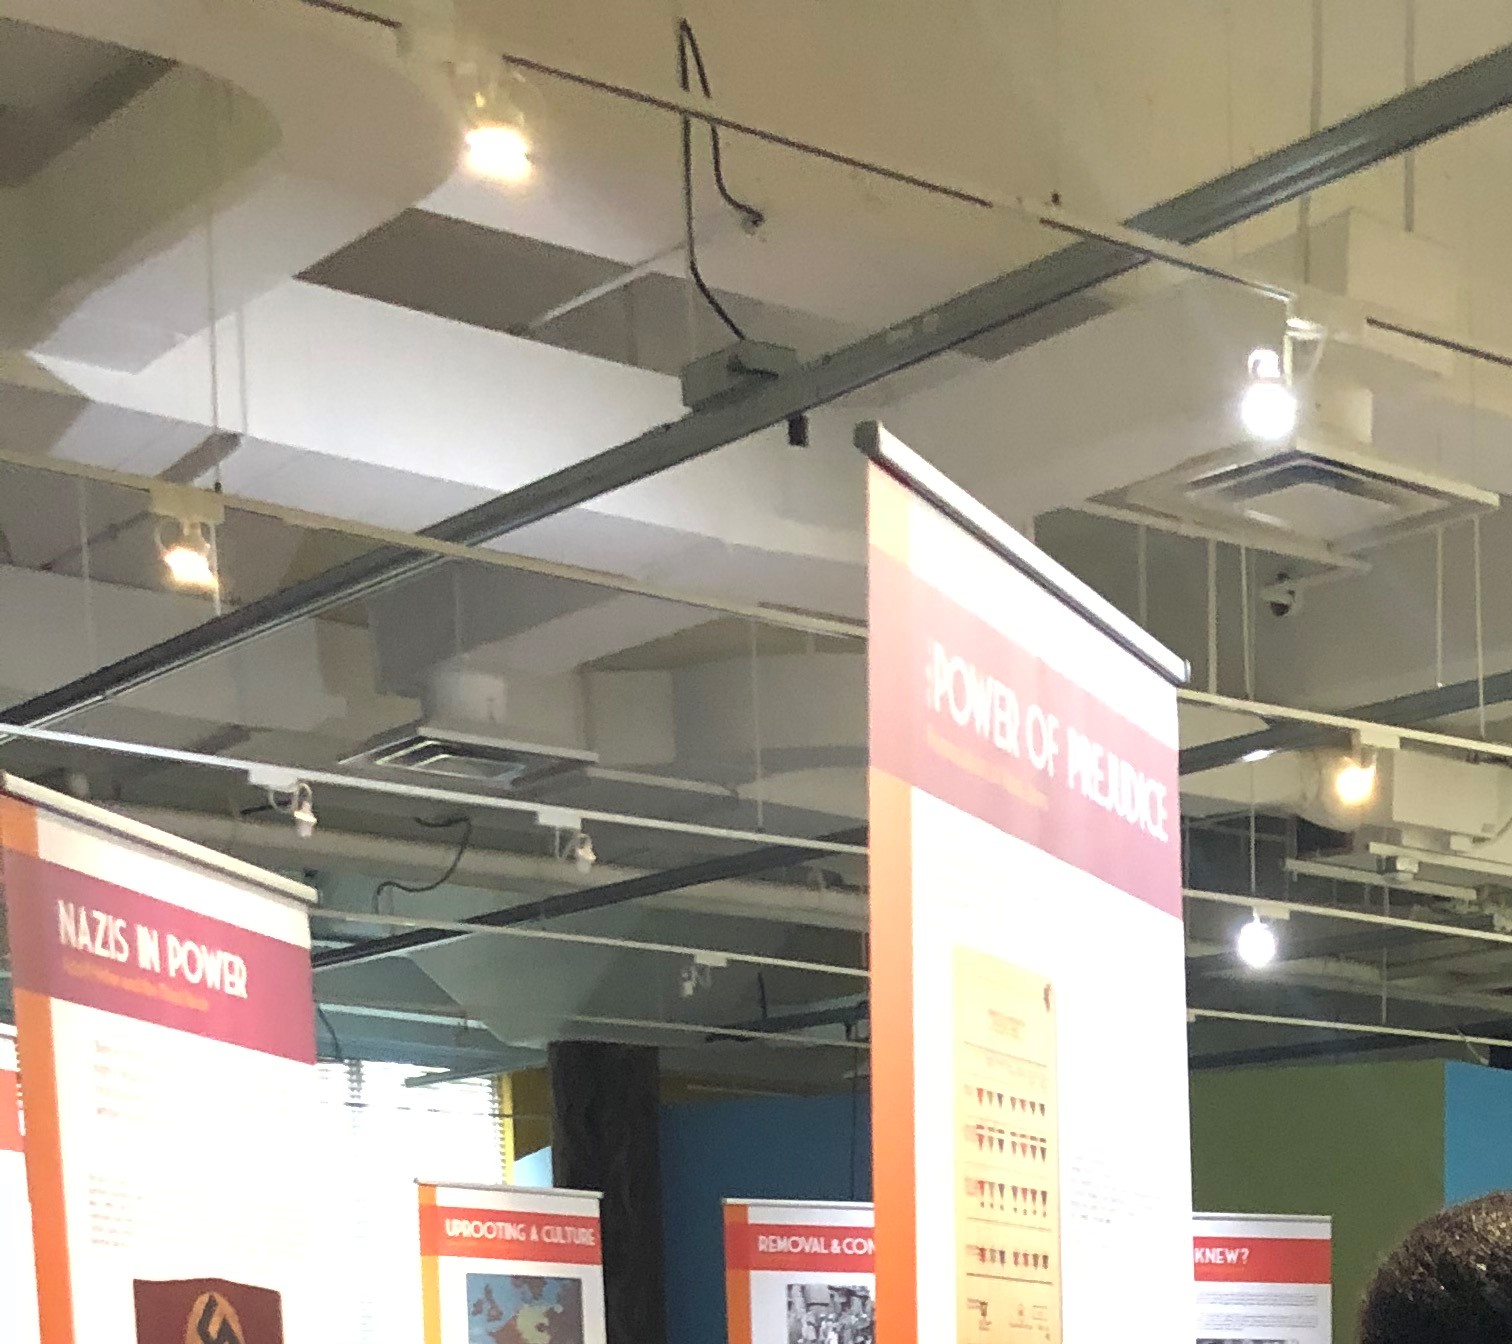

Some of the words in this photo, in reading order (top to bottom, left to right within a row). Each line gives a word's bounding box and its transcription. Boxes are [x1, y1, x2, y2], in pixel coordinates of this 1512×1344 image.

[930, 639, 1020, 758] POWER
[1025, 703, 1060, 778] OF
[1067, 725, 1169, 843] PREJUDICE
[57, 899, 129, 963] NAZIS
[136, 924, 160, 973] IN
[167, 933, 248, 998] POWER
[445, 1218, 526, 1241] UPROOTING
[529, 1224, 540, 1242] A
[541, 1225, 596, 1246] CULTURE
[758, 1235, 829, 1253] REMOVAL
[1194, 1247, 1249, 1264] KNEW?
